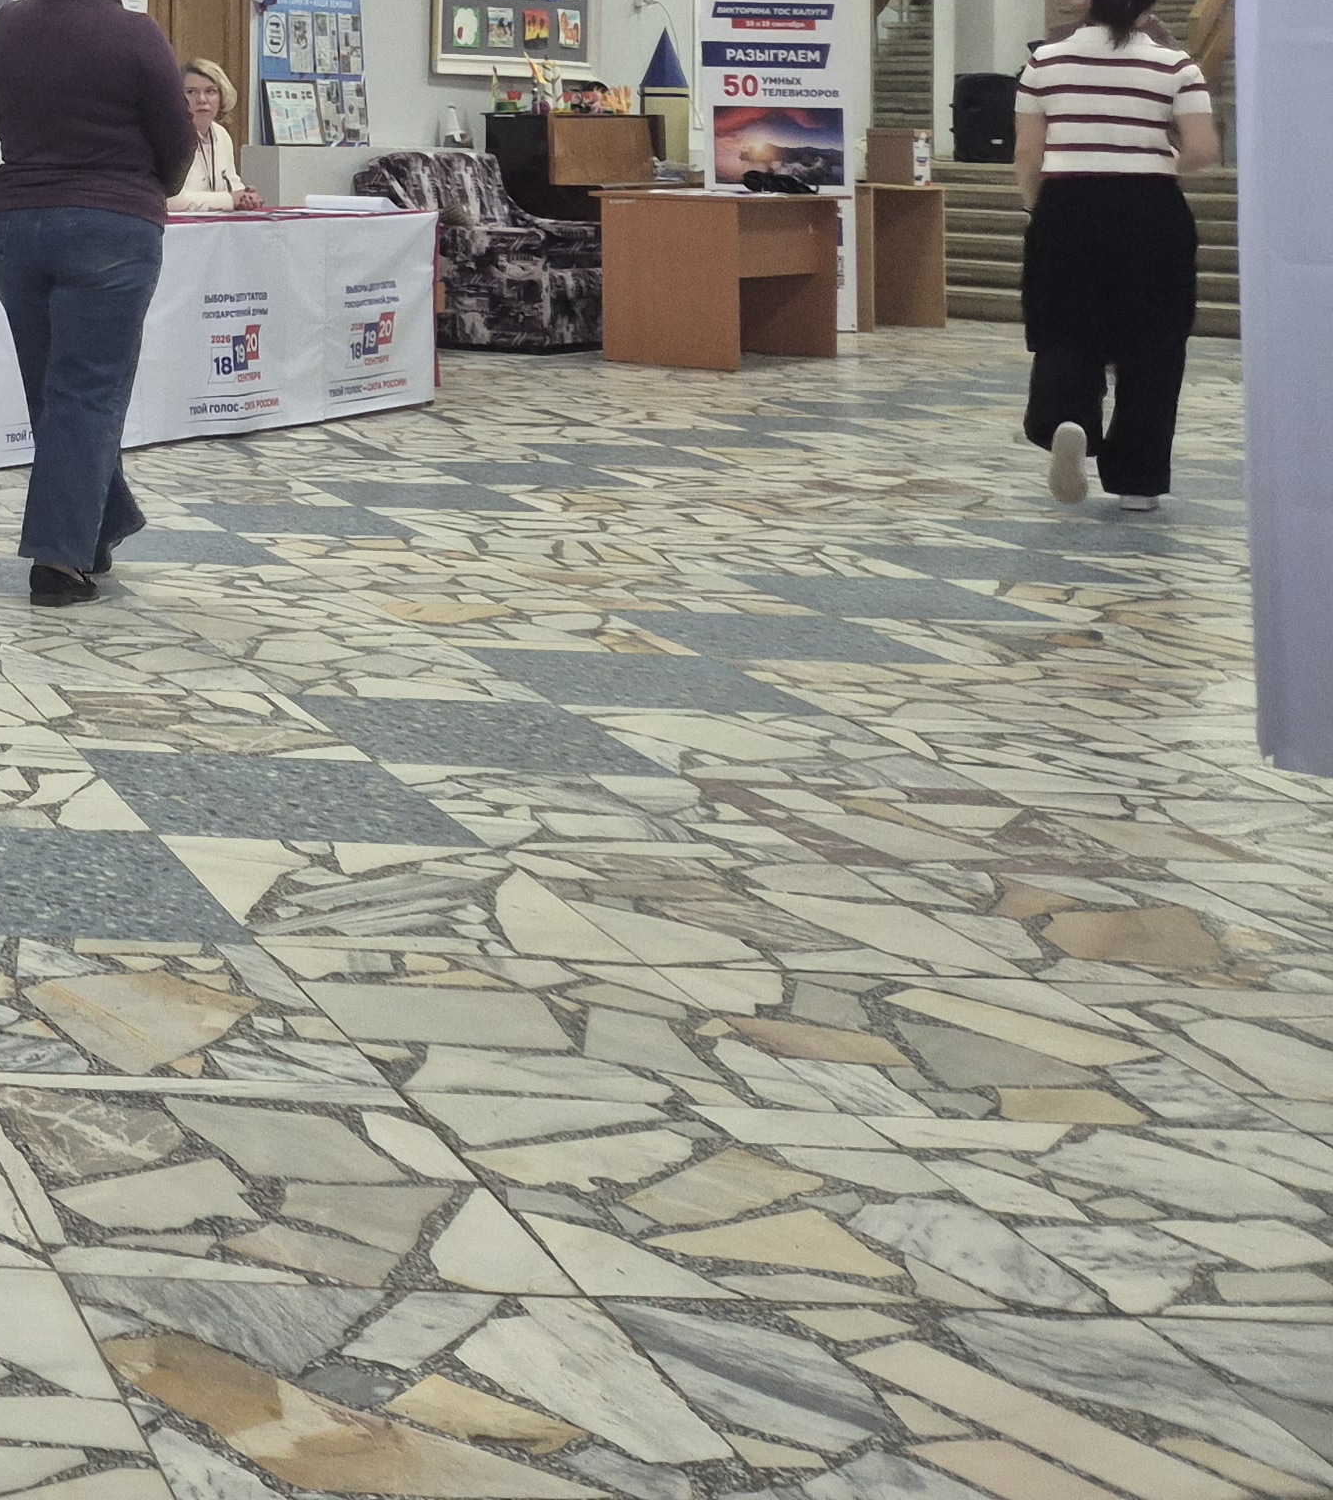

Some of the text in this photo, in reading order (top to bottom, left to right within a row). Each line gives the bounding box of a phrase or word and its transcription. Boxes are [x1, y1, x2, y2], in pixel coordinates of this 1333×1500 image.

[773, 8, 791, 16] ТОС
[725, 48, 821, 63] РАЗЫГРАЕМ
[723, 74, 759, 97] 50
[761, 77, 802, 86] УМНЫХ
[761, 88, 840, 98] ТЕЛЕВИЗОРОВ
[211, 334, 231, 344] 2026
[350, 319, 392, 360] 18 19 20
[214, 333, 257, 375] 18 19 20
[189, 403, 208, 415] ТВОЙ
[209, 403, 239, 413] ГОЛОС
[5, 430, 27, 443] ТВОЙ
